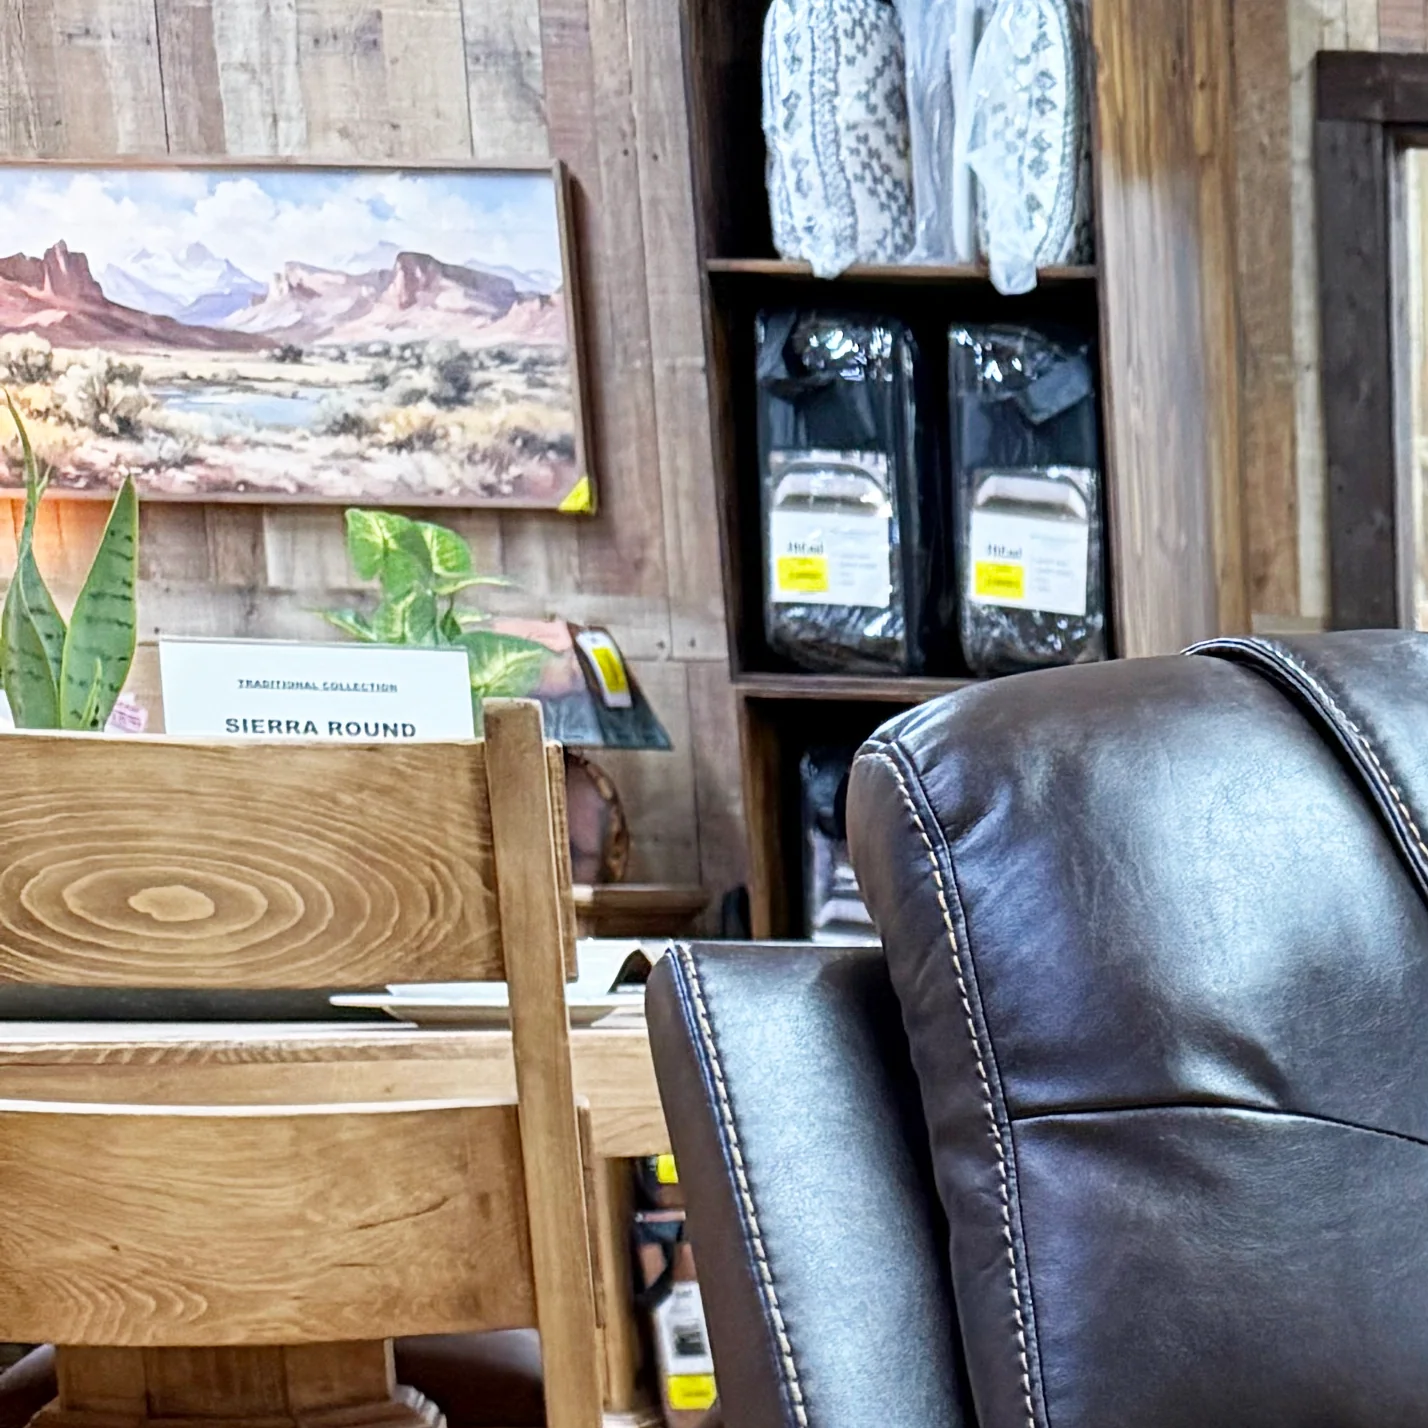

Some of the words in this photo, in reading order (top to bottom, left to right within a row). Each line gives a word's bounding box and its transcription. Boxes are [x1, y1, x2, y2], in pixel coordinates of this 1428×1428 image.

[322, 681, 398, 693] COLLECTION
[225, 717, 319, 736] SIERRA
[328, 720, 417, 738] ROUND
